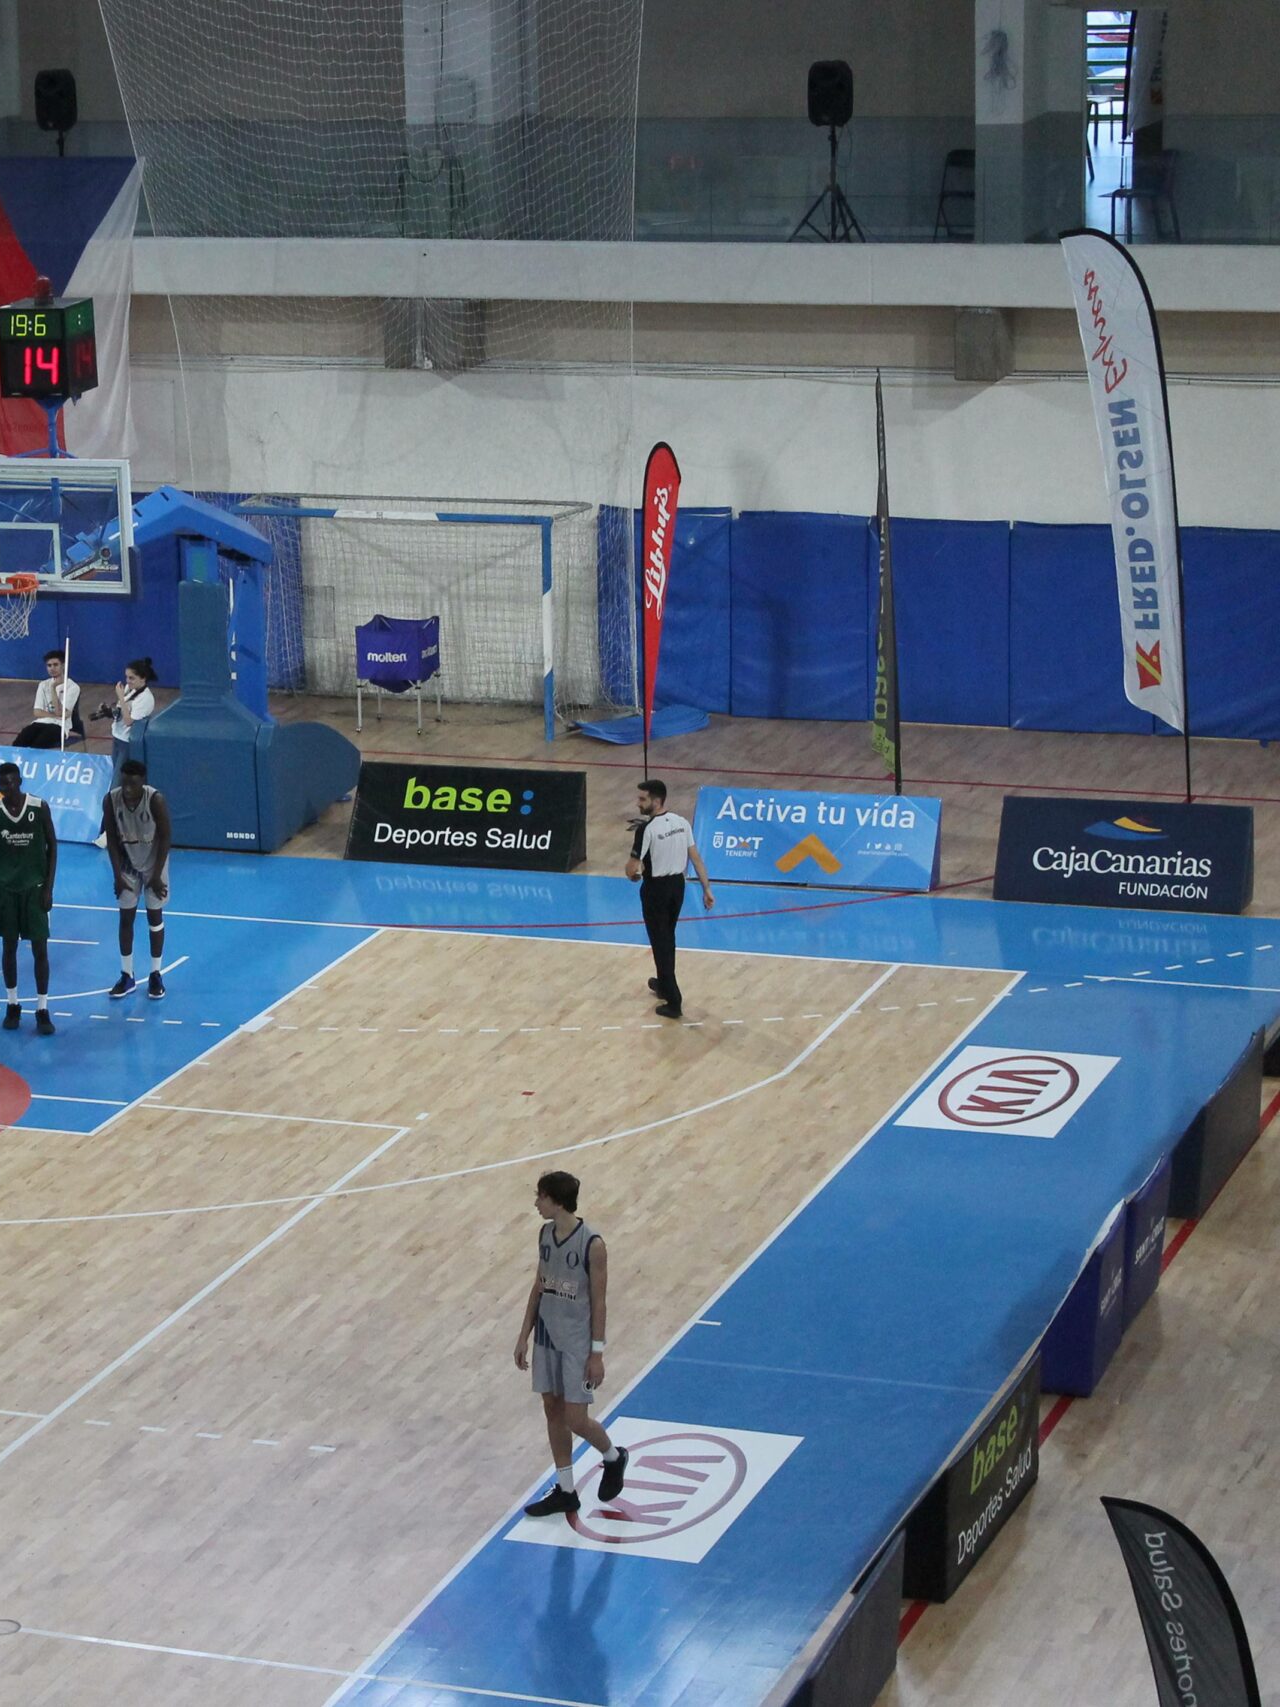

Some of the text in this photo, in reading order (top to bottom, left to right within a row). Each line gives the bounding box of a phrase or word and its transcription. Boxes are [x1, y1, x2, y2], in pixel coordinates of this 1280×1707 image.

[24, 347, 59, 385] 14
[367, 652, 407, 662] molten
[45, 759, 95, 785] vida
[27, 811, 35, 822] 0
[716, 795, 916, 829] Activa tu vida
[226, 831, 256, 840] MONDO
[373, 823, 552, 850] Deportes Salud
[1032, 845, 1212, 878] CajaCanarias
[1118, 882, 1208, 899] FUNDACIÓN
[957, 1437, 1032, 1565] Deportes Salud
